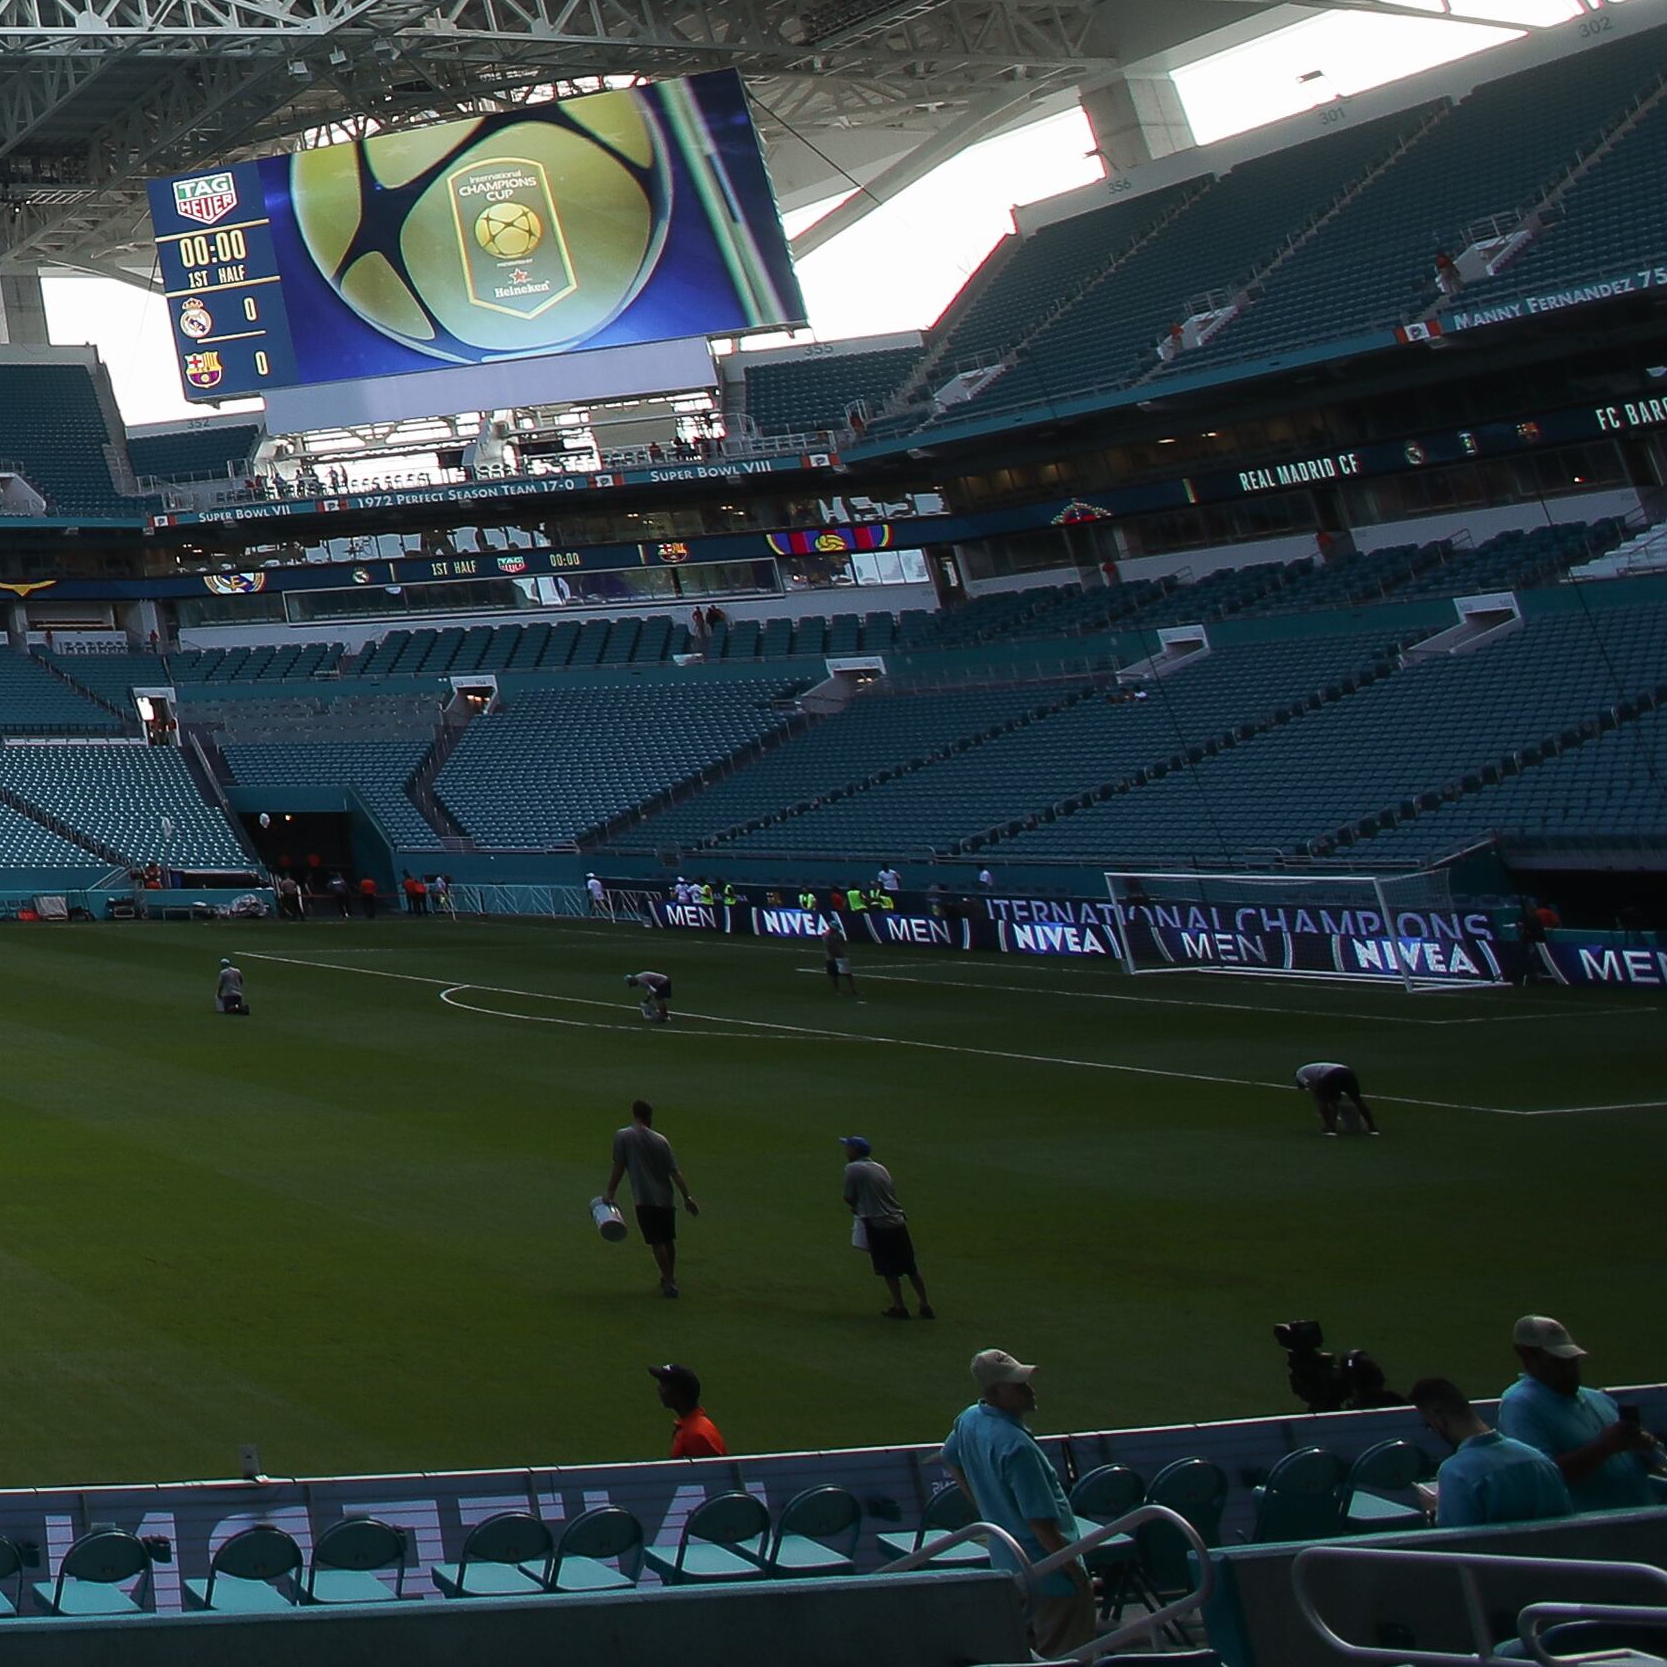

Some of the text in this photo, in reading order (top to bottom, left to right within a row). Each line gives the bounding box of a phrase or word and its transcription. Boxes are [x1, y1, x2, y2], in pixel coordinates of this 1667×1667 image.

[1579, 16, 1612, 38] 302
[1319, 108, 1345, 125] 301
[179, 176, 229, 198] TAG
[459, 177, 537, 196] CHAMPIONS
[469, 169, 521, 183] International
[1108, 178, 1131, 195] 356
[486, 189, 514, 201] CUP
[180, 194, 234, 220] HEUER
[179, 230, 246, 268] 00:00
[188, 265, 245, 288] 1ST HALF
[494, 282, 549, 298] Heineken
[244, 297, 257, 321] 0
[1453, 304, 1522, 331] MANNY
[1525, 278, 1636, 314] FERNANDEZ
[804, 344, 833, 356] 355
[256, 352, 268, 375] 0
[187, 418, 210, 429] 352
[1595, 406, 1620, 430] FC
[745, 460, 772, 473] VIII
[1239, 454, 1357, 491] REAL MADRID CF
[357, 496, 394, 509] 1972
[542, 480, 574, 493] 17-0
[272, 504, 291, 516] VII
[431, 560, 477, 576] 1ST HALF
[549, 552, 580, 567] 00:00
[666, 904, 717, 929] MEN
[763, 910, 830, 937] NIVEA
[886, 917, 952, 944] MEN
[1013, 923, 1107, 954] NIVEA
[1180, 931, 1267, 962] MEN
[1352, 937, 1480, 974] NIVEA
